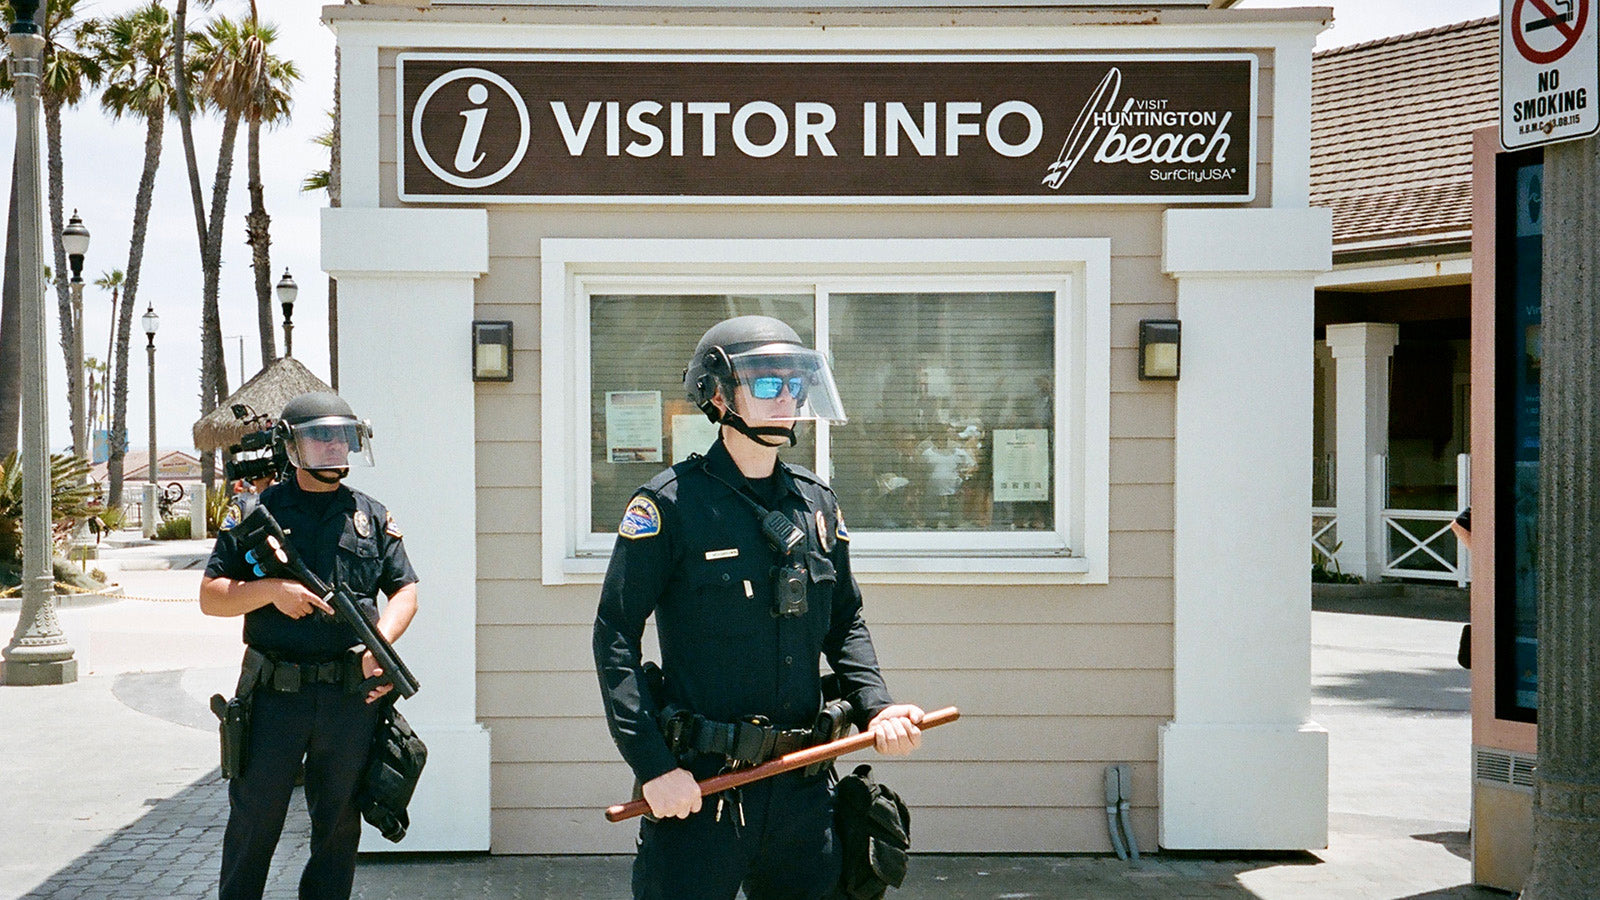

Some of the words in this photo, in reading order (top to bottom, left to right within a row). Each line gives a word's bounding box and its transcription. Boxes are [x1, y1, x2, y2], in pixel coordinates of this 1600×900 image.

[1538, 69, 1560, 93] NO
[1093, 111, 1216, 127] HUNTINGTON
[1136, 99, 1168, 110] VISIT
[1513, 87, 1587, 123] SMOKING
[550, 101, 837, 157] VISITOR
[864, 101, 1043, 157] INFO
[1093, 97, 1233, 164] beach
